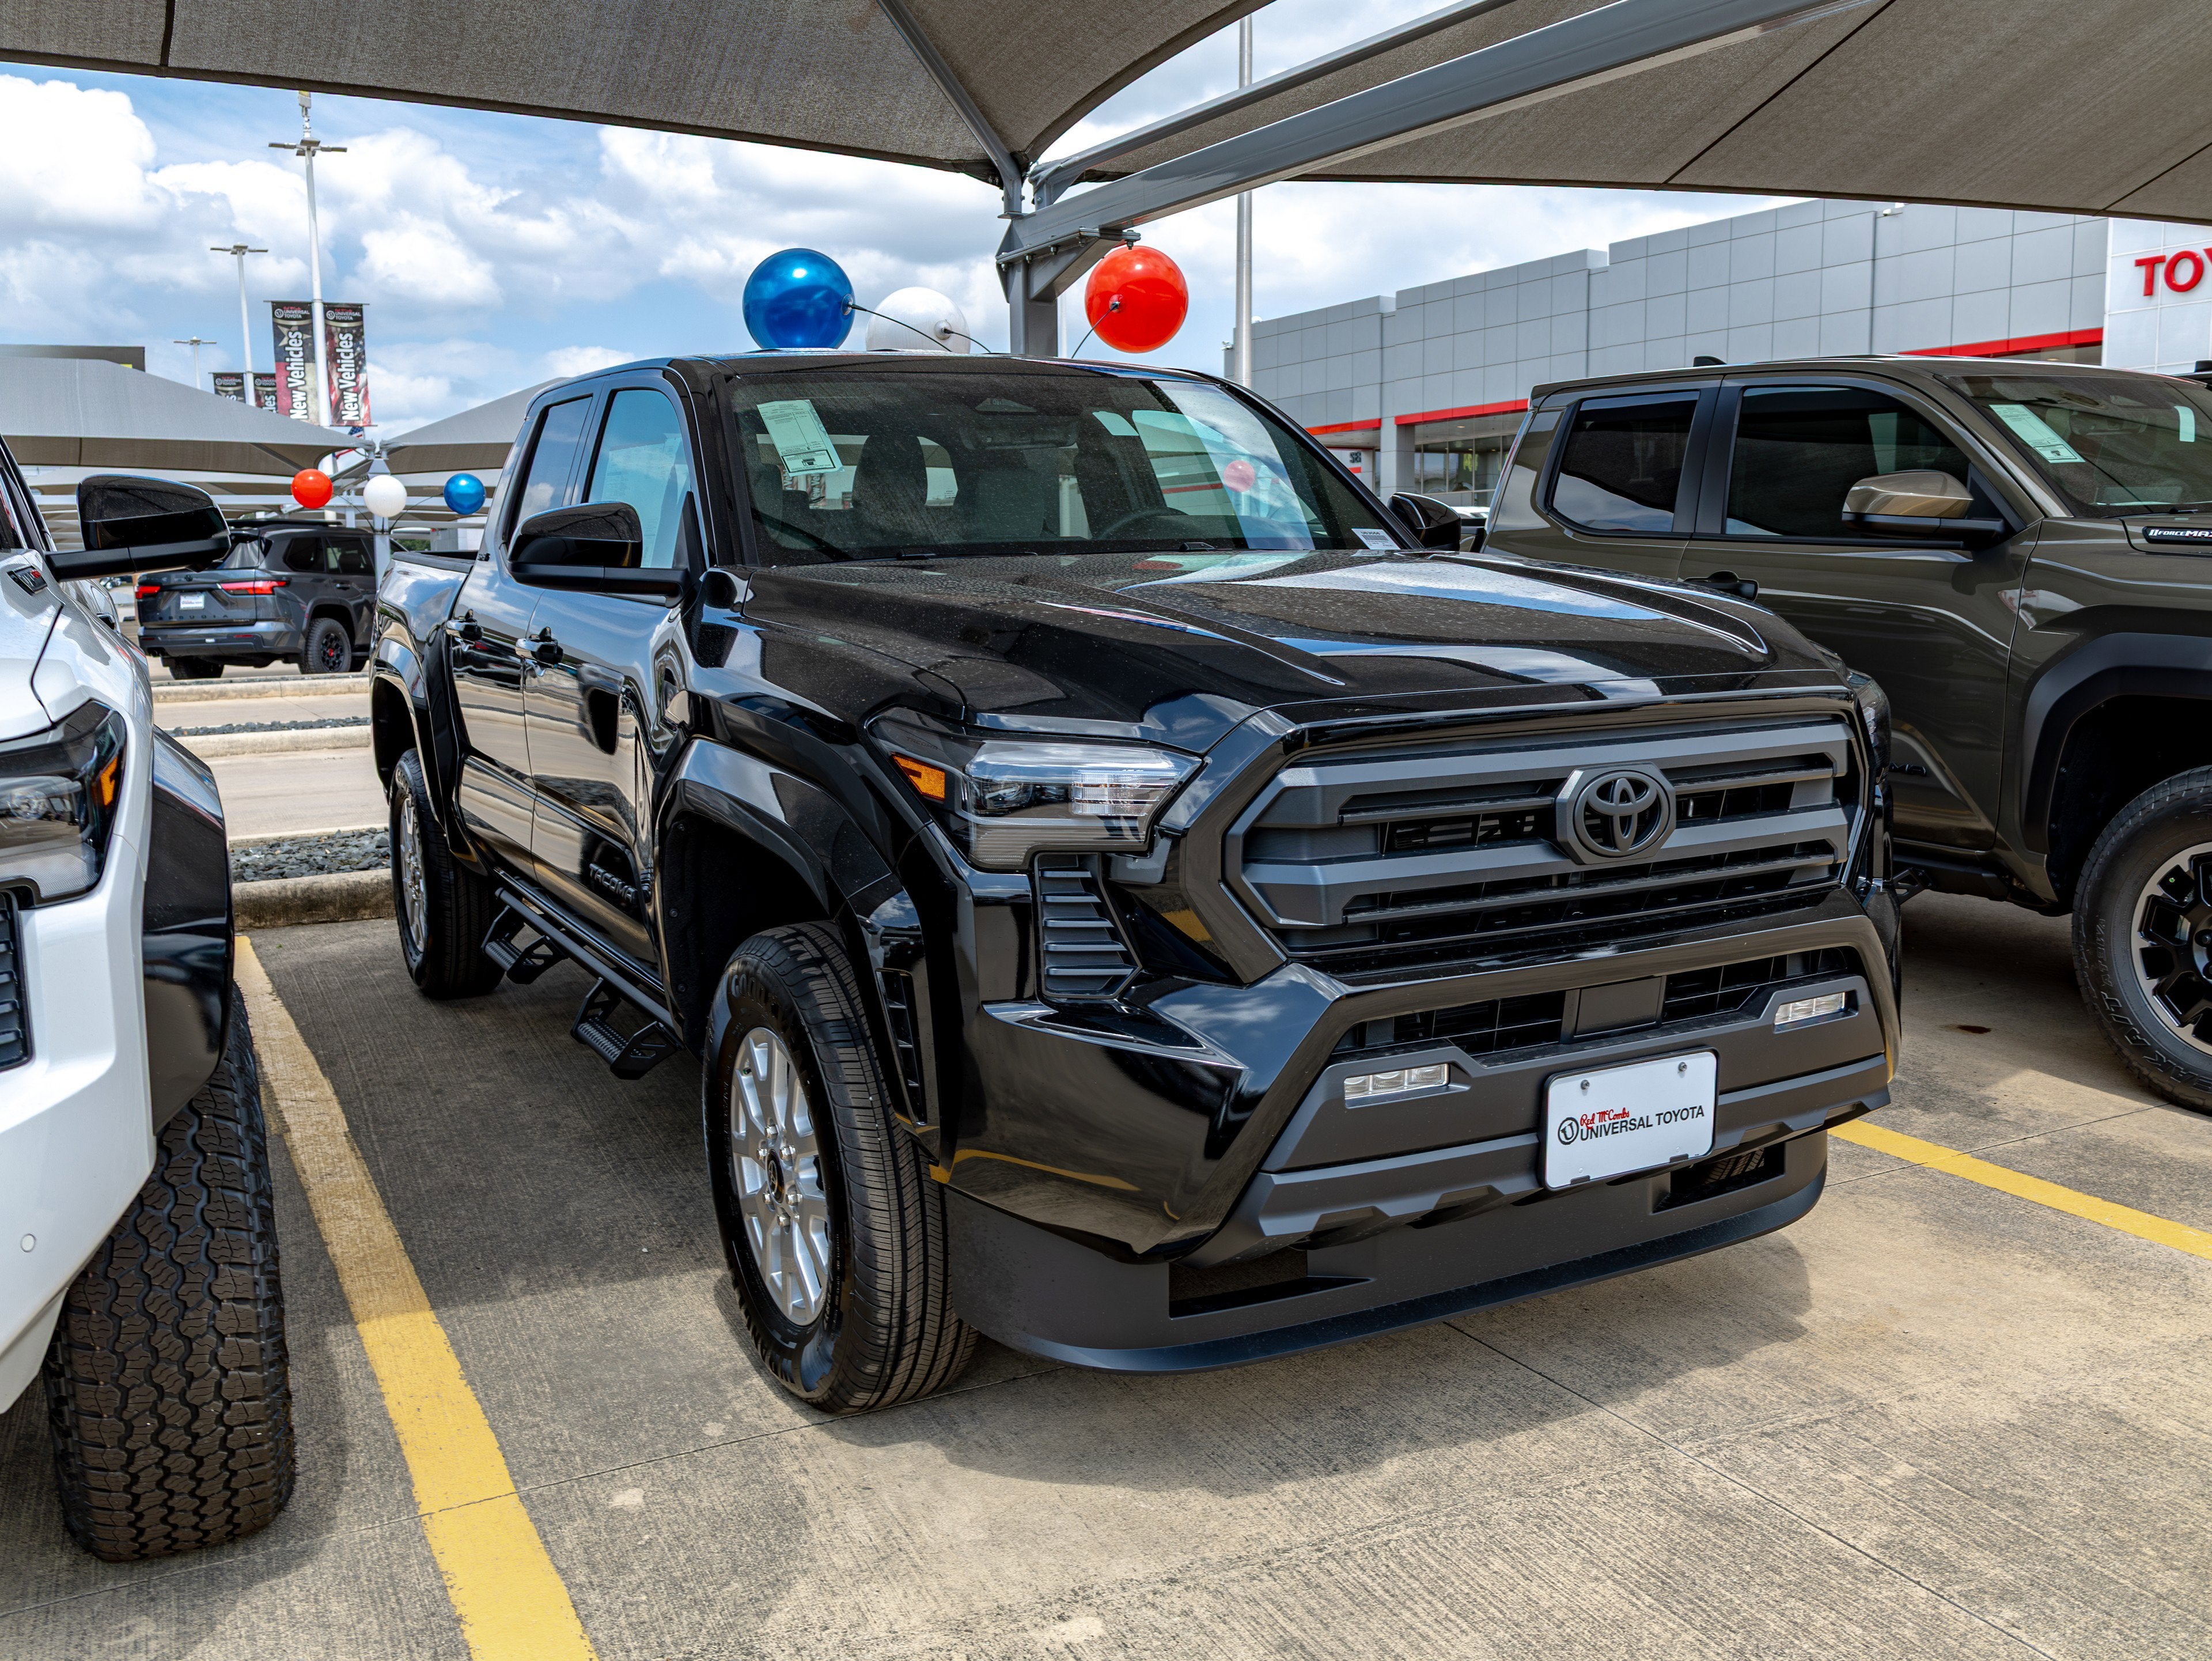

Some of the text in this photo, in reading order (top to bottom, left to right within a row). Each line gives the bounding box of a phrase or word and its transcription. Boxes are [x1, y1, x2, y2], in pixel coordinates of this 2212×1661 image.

[285, 331, 305, 388] Vehicles
[336, 333, 357, 389] Vehicles
[290, 390, 308, 419] New
[342, 392, 359, 420] New
[589, 863, 635, 903] TACOMA
[1580, 1107, 1630, 1129] Red McCombs
[1580, 1105, 1705, 1141] UNIVERSAL TOYOTA
